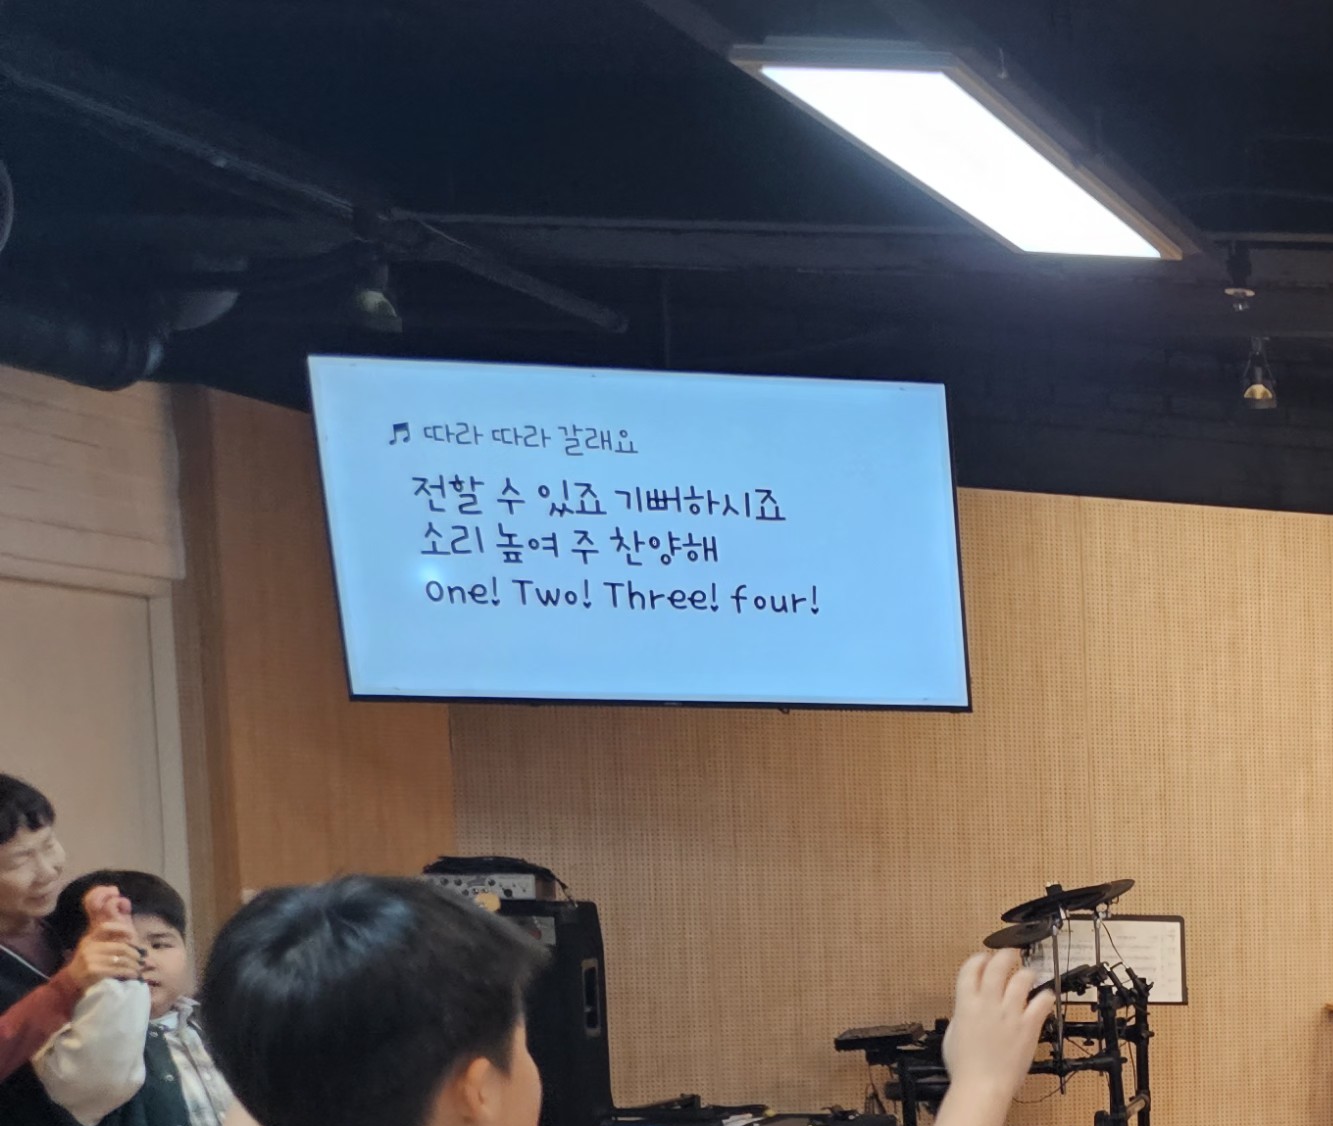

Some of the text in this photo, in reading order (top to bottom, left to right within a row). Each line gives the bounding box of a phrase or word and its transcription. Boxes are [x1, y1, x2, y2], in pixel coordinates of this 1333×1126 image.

[423, 422, 639, 457] 따라 따라 갈래요
[411, 473, 787, 522] 전할 수 있죠 기뻐하시죠
[420, 521, 719, 567] 소리 높여 주 찬양해
[511, 578, 592, 610] Two!
[602, 579, 720, 613] Three!
[729, 584, 820, 615] four!
